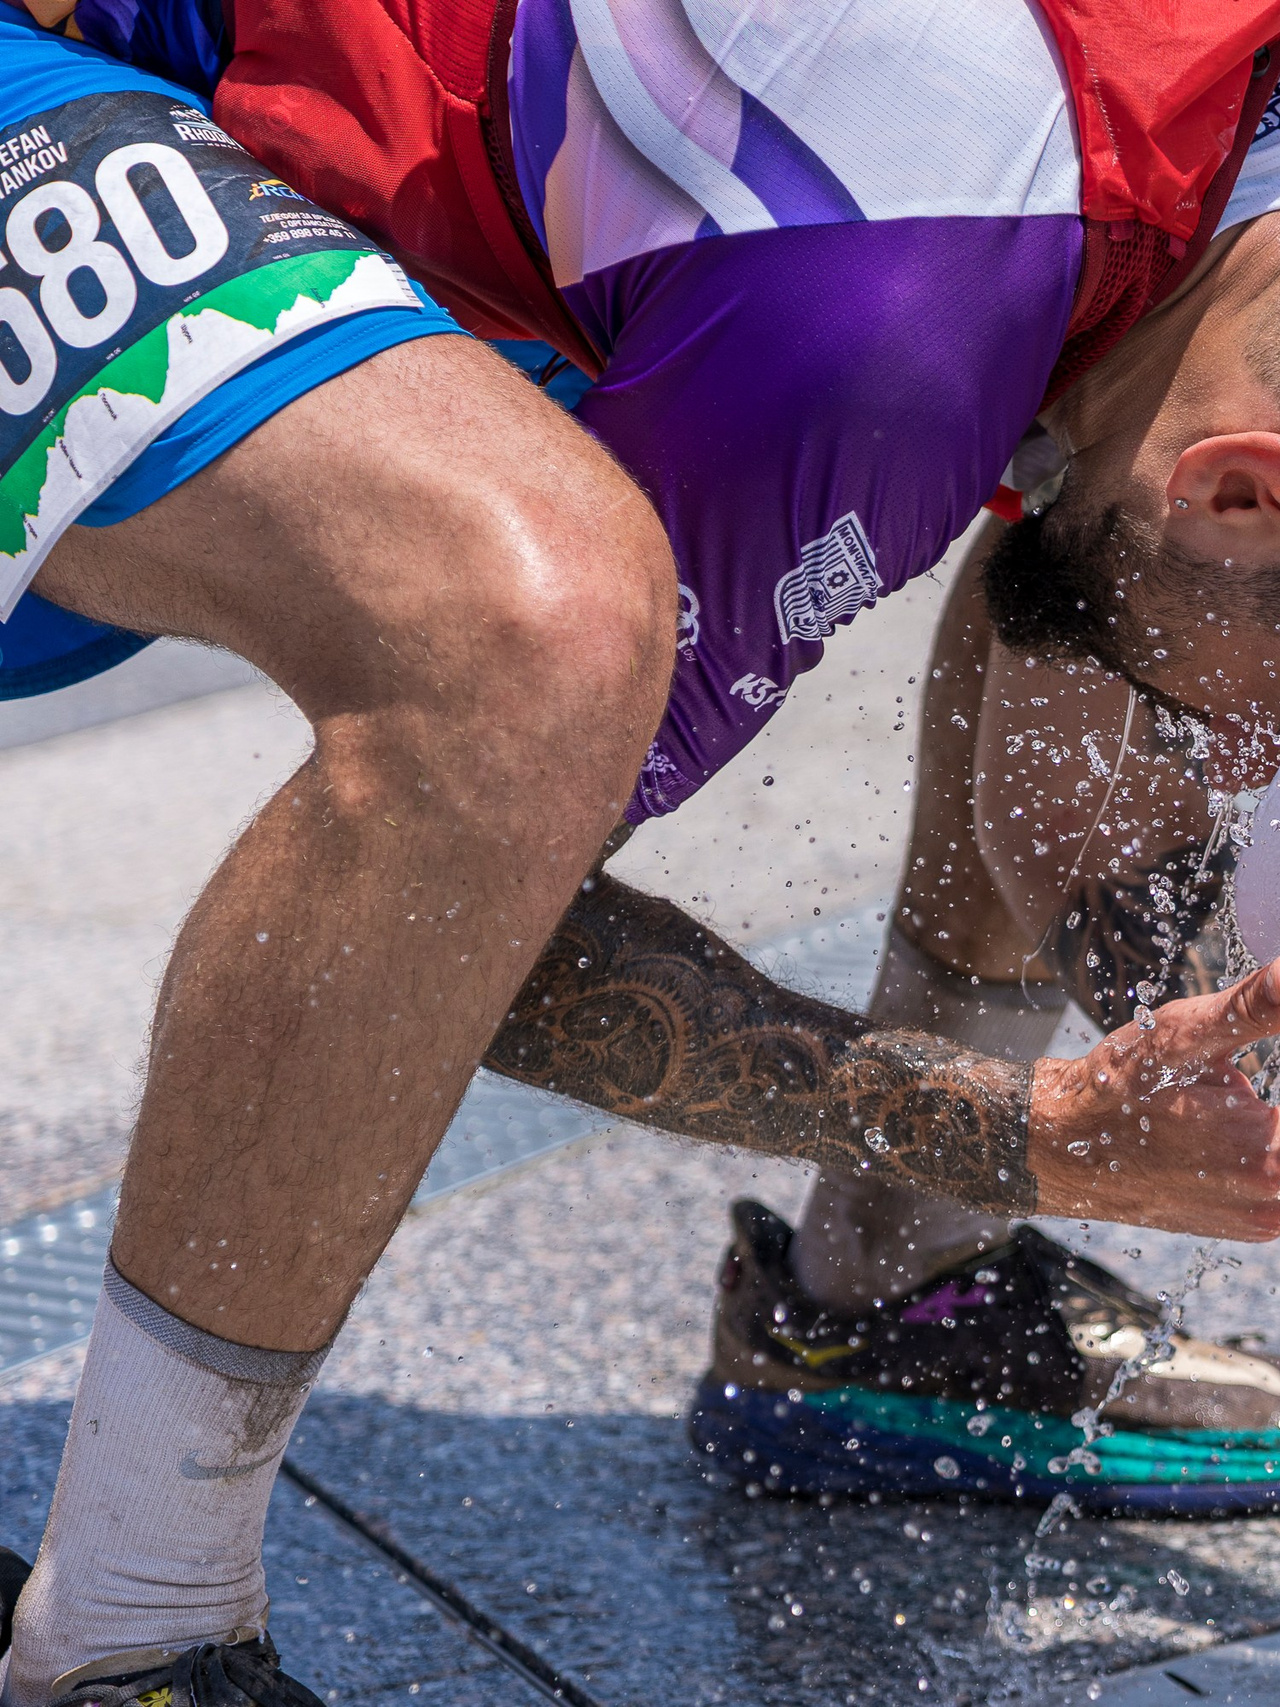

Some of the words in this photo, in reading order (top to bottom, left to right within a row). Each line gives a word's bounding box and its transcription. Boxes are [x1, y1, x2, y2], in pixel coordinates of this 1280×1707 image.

[0, 141, 68, 199] ANKOV
[259, 212, 300, 224] ТЕЛЕФОН
[263, 231, 291, 244] +359
[290, 228, 314, 239] 898
[312, 228, 329, 237] 62
